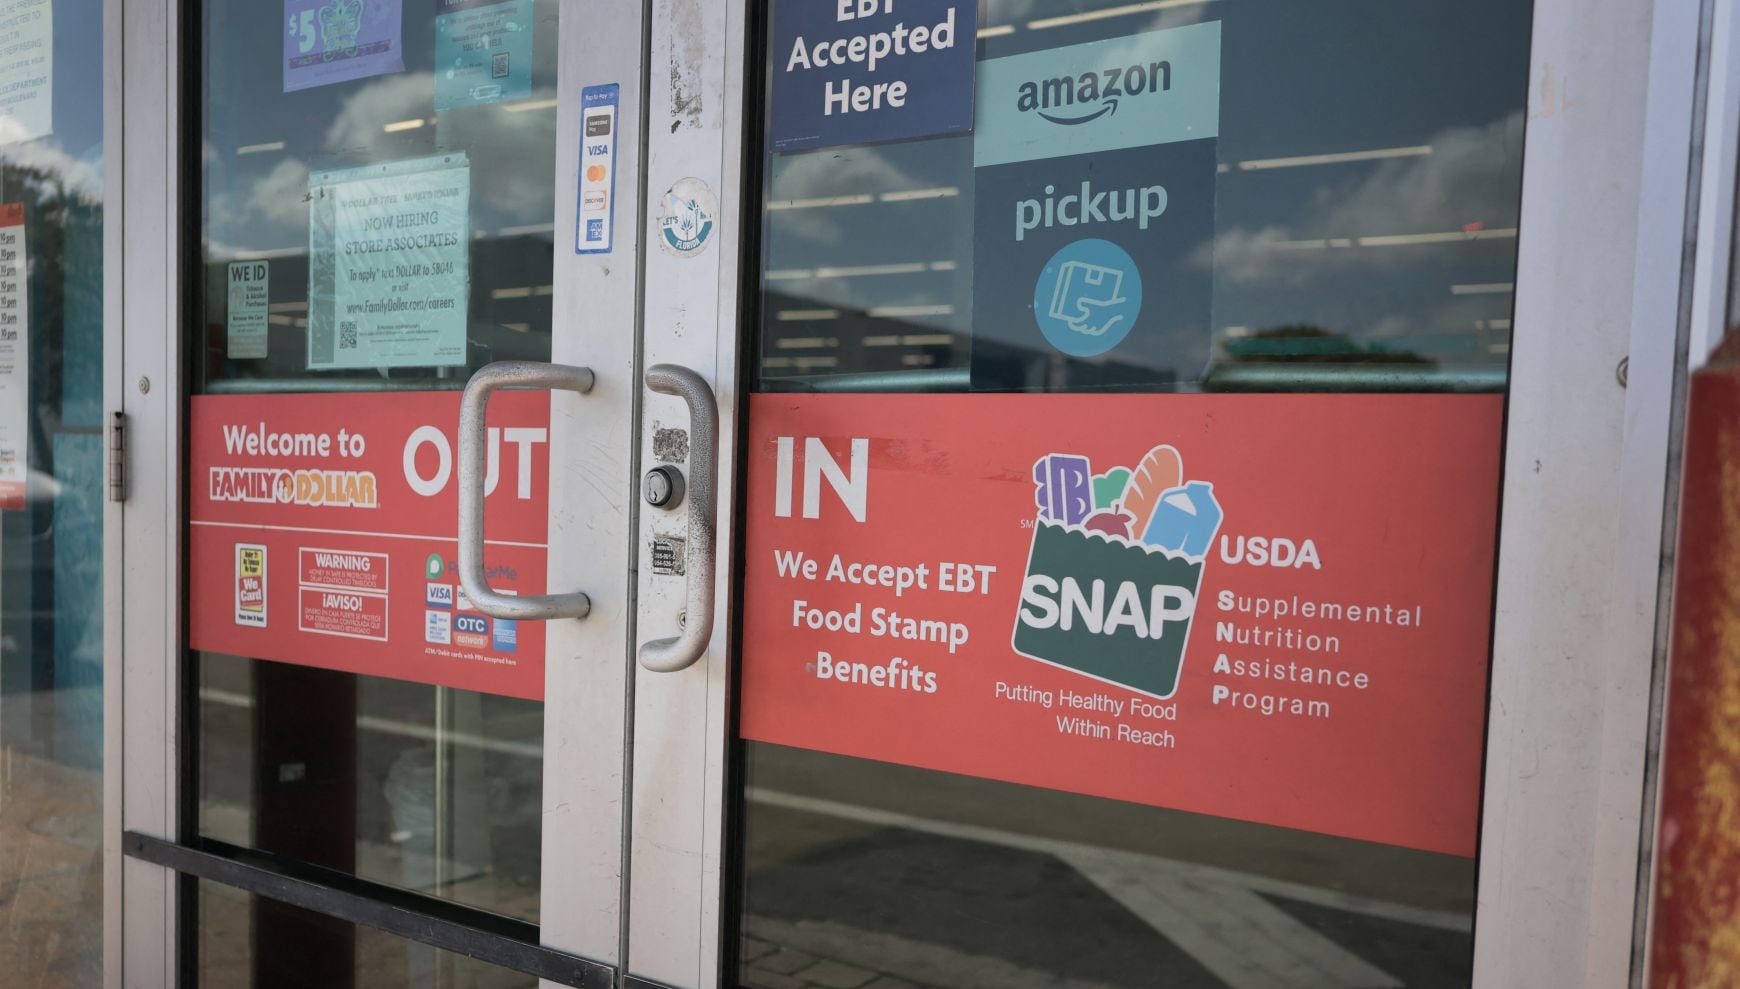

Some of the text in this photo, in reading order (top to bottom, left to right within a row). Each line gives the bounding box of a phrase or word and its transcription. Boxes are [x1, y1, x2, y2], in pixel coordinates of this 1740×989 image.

[786, 7, 955, 72] Accepted
[1017, 59, 1171, 113] amazon
[824, 79, 907, 116] Here
[588, 145, 608, 156] VISA
[1015, 180, 1168, 241] pickup
[364, 210, 439, 232] NOW HIRING
[6, 234, 15, 244] pm
[345, 232, 458, 255] STORE ASSOCIATES
[675, 237, 701, 250] FLORIDA
[7, 250, 16, 260] pm
[7, 266, 16, 276] pm
[231, 264, 266, 282] WE ID
[349, 269, 357, 281] To
[396, 264, 421, 278] DOLLAR
[422, 264, 430, 276] to
[7, 282, 16, 293] pm
[7, 298, 16, 309] pm
[346, 296, 455, 315] www.FamilyDollar.com/careers
[1, 313, 17, 325] 10 pm
[1, 329, 17, 340] 10 pm
[223, 421, 365, 458] Welcome to
[210, 466, 377, 508] FAMILY DOLLAR
[774, 436, 869, 523] IN
[1020, 519, 1034, 529] SM
[1219, 534, 1321, 570] USDA
[315, 553, 371, 572] WARNING
[448, 560, 518, 581] ParMe
[323, 577, 352, 585] CONTROLLED
[347, 572, 371, 580] PROTECTED
[774, 549, 997, 596] We Accept EBT
[243, 578, 258, 590] We
[430, 587, 451, 600] VISA
[241, 589, 262, 602] Card
[323, 593, 362, 612] ¡AVISO!
[1019, 573, 1197, 640] SNAP
[1217, 589, 1421, 627] Supplemental
[457, 617, 485, 632] OTC
[792, 600, 969, 654] Food Stamp
[457, 635, 484, 645] network
[1216, 622, 1340, 653] Nutrition
[425, 648, 450, 657] ATM/Debit
[484, 655, 504, 664] accepted
[505, 658, 517, 666] here
[816, 651, 938, 693] Benefits
[1213, 654, 1369, 689] Assistance
[994, 682, 1177, 721] Putting Healthy Food
[1212, 685, 1330, 718] Program
[1055, 715, 1175, 748] Within Reach
